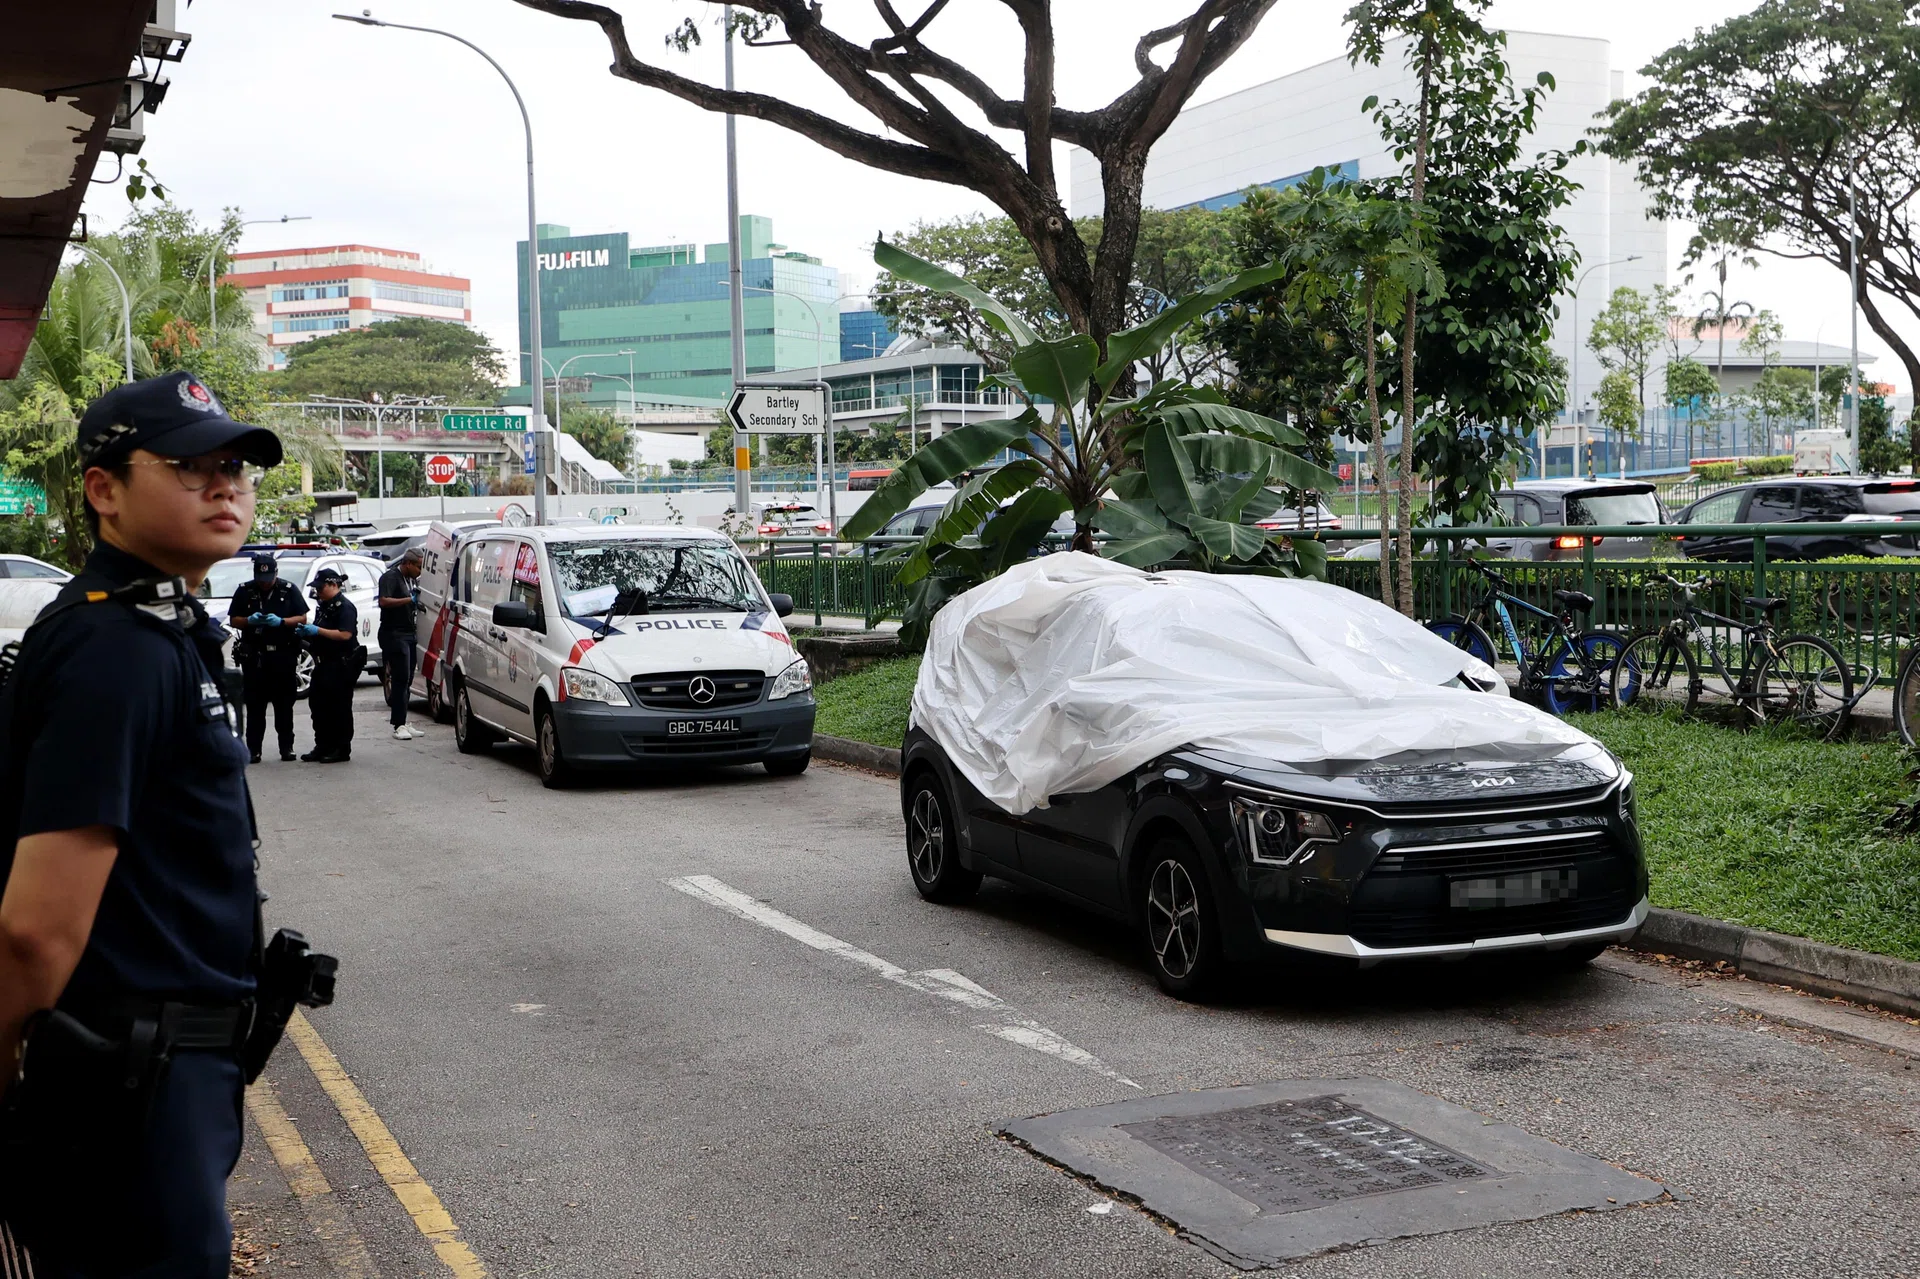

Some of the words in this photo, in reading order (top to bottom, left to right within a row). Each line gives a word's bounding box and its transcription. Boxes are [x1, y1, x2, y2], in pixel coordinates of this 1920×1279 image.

[537, 249, 609, 270] FUJIFILM
[767, 396, 799, 411] Bartley
[451, 417, 497, 429] Little
[505, 417, 522, 429] Rd
[750, 413, 796, 428] Secondary
[803, 414, 818, 426] Sch
[428, 463, 454, 476] STOP
[635, 619, 727, 632] POLICE
